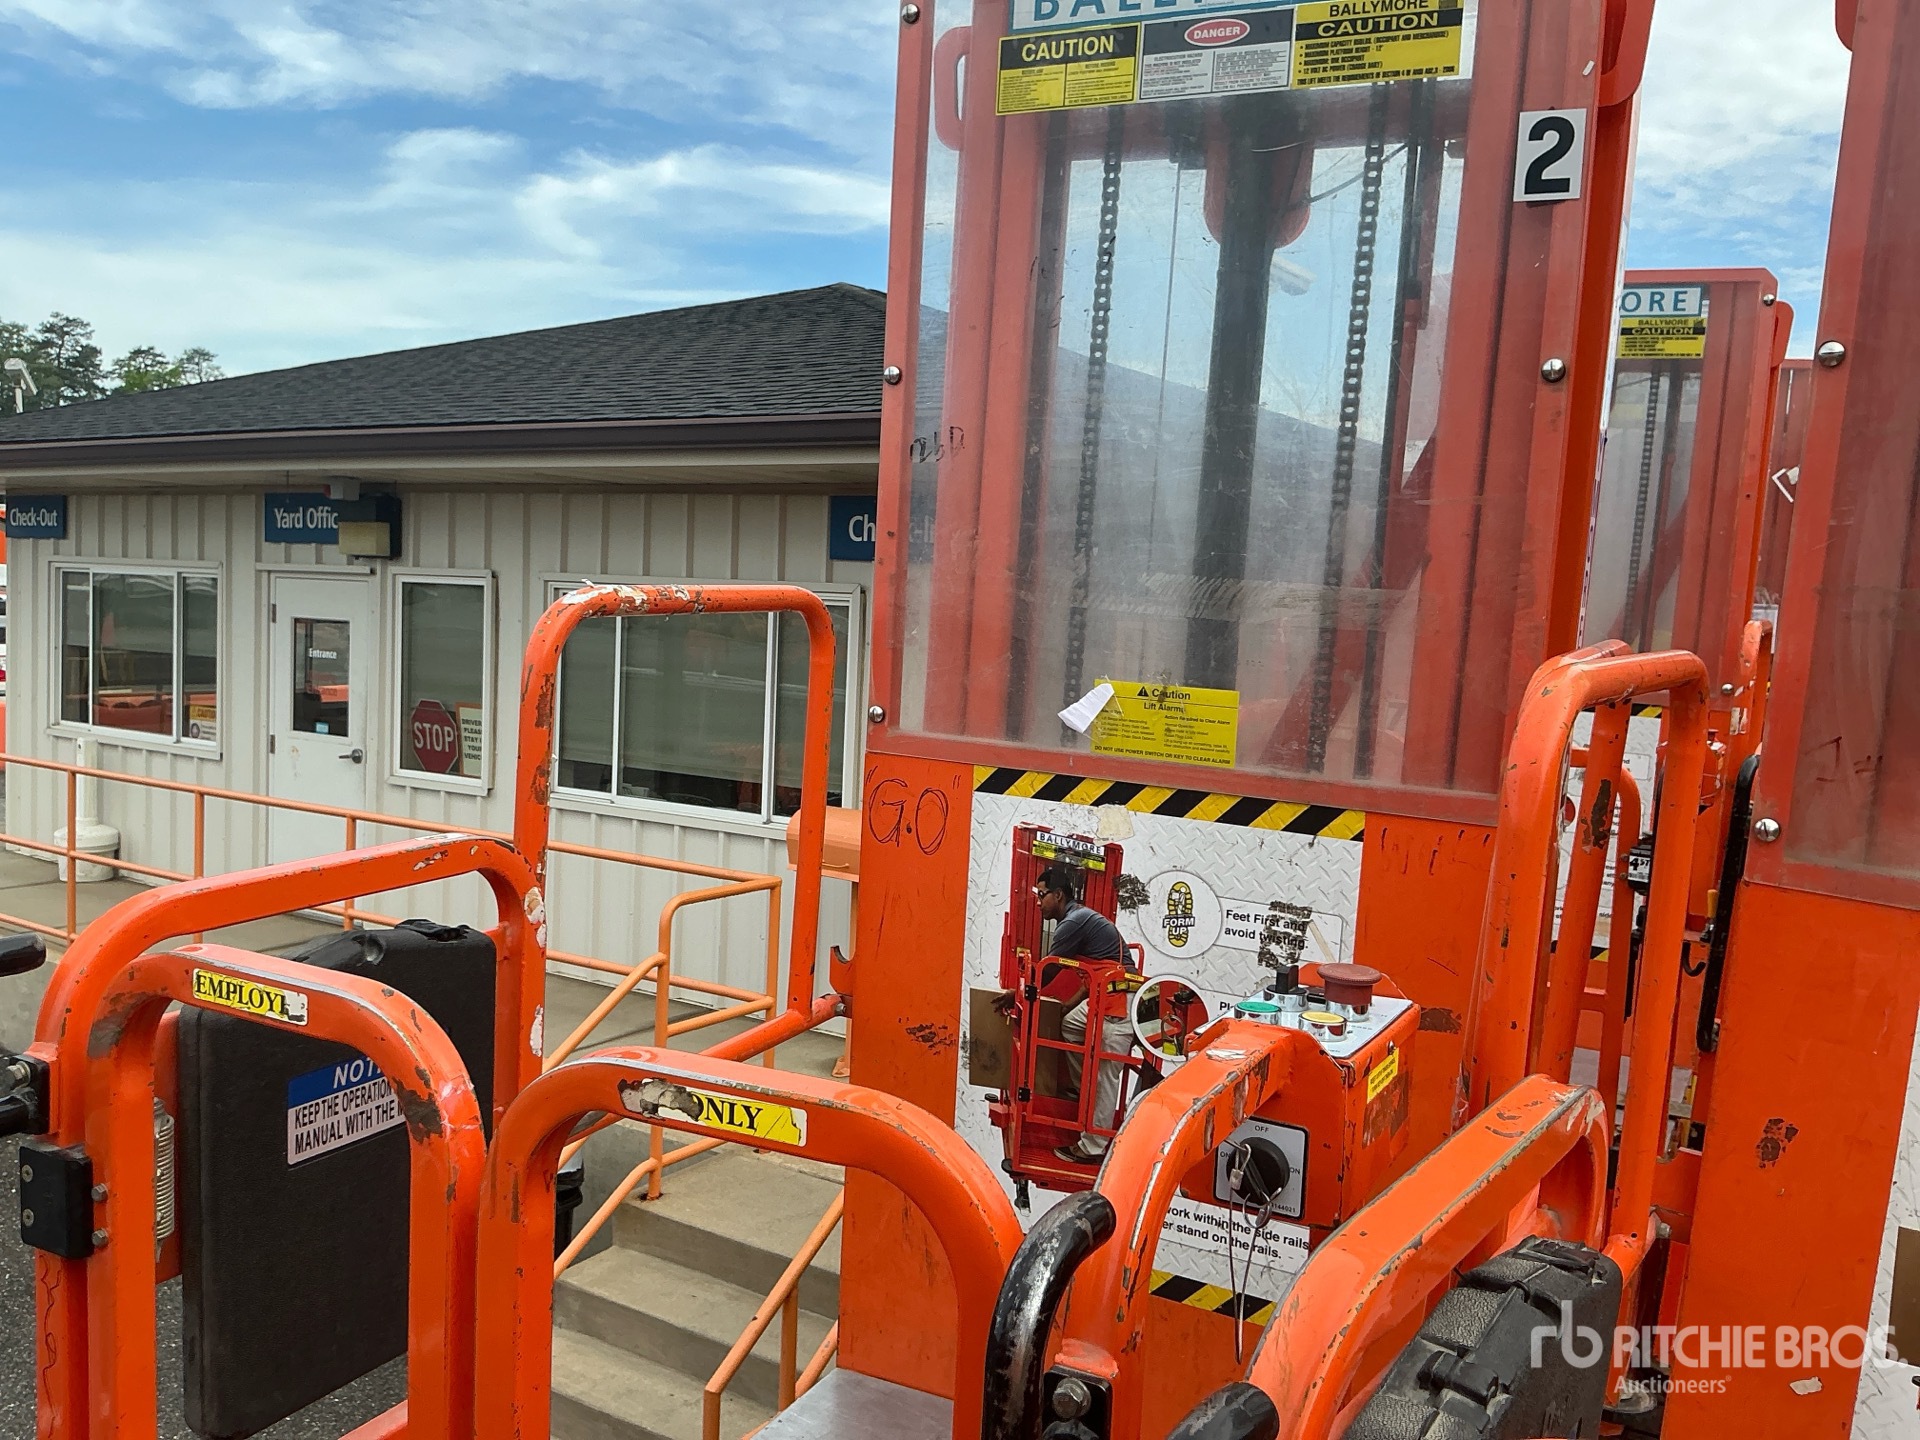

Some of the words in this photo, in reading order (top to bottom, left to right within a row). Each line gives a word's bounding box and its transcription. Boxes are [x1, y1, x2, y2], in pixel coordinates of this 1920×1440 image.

[1329, 0, 1429, 17] BALLYMORE
[1193, 26, 1241, 40] DANGER
[1317, 12, 1439, 37] CAUTION
[1021, 35, 1115, 62] CAUTION
[1525, 116, 1575, 194] 2
[1631, 327, 1694, 335] CAUTION
[10, 507, 58, 527] Check-Out
[274, 506, 303, 529] Yard
[307, 506, 339, 529] Offic
[309, 648, 337, 659] Entrance
[1144, 702, 1156, 711] Lift
[413, 721, 454, 753] STOP
[463, 727, 482, 735] PLEAS
[464, 752, 482, 760] VEHIC
[1040, 833, 1101, 854] BALLYMORE
[1163, 916, 1195, 929] FORM
[1226, 909, 1251, 923] Feet
[1254, 914, 1280, 928] First
[1283, 918, 1306, 931] and
[1172, 927, 1187, 936] UP
[1224, 927, 1256, 940] avoid
[1259, 931, 1309, 950] twisting.
[295, 1101, 320, 1129] KEEP
[321, 1095, 340, 1119] THE
[295, 1120, 344, 1155] MANUAL
[345, 1108, 373, 1136] WITH
[375, 1100, 395, 1125] THE
[1254, 1125, 1270, 1133] OFF
[1193, 1211, 1229, 1229] within
[1232, 1220, 1251, 1235] the
[1255, 1227, 1284, 1242] side
[1176, 1222, 1209, 1240] stand
[1212, 1233, 1228, 1244] on
[1231, 1236, 1250, 1251] the
[1252, 1243, 1282, 1259] rails.
